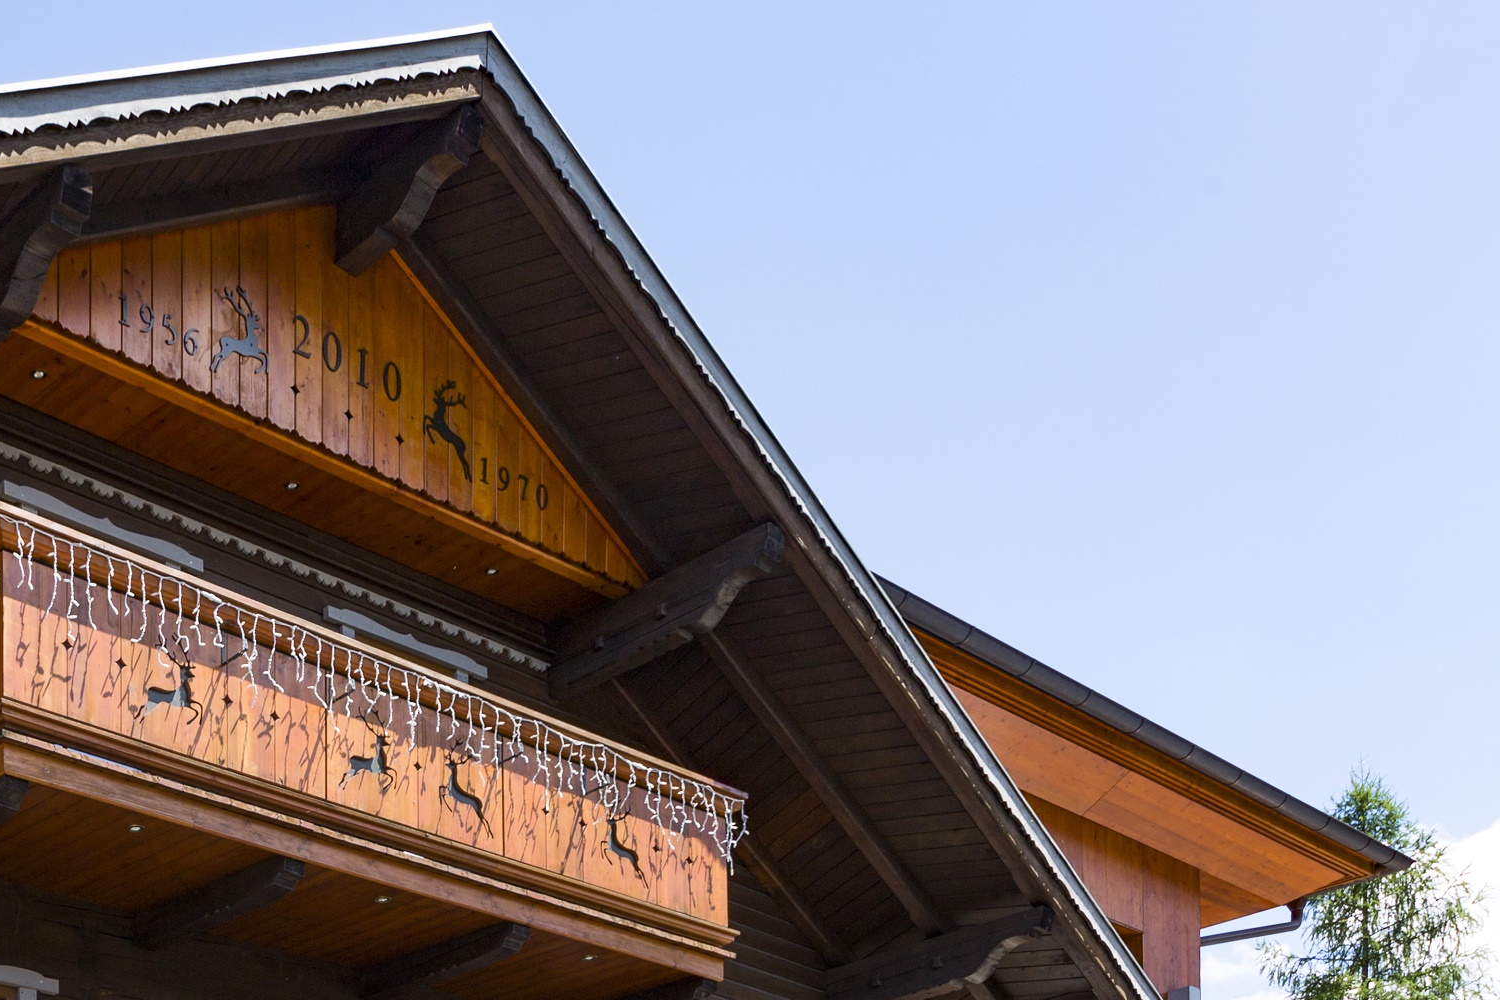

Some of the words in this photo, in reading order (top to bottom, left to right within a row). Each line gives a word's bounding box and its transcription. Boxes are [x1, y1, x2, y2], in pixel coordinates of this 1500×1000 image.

[118, 295, 199, 356] 1956
[292, 315, 402, 402] 2010
[480, 457, 549, 511] 1970
